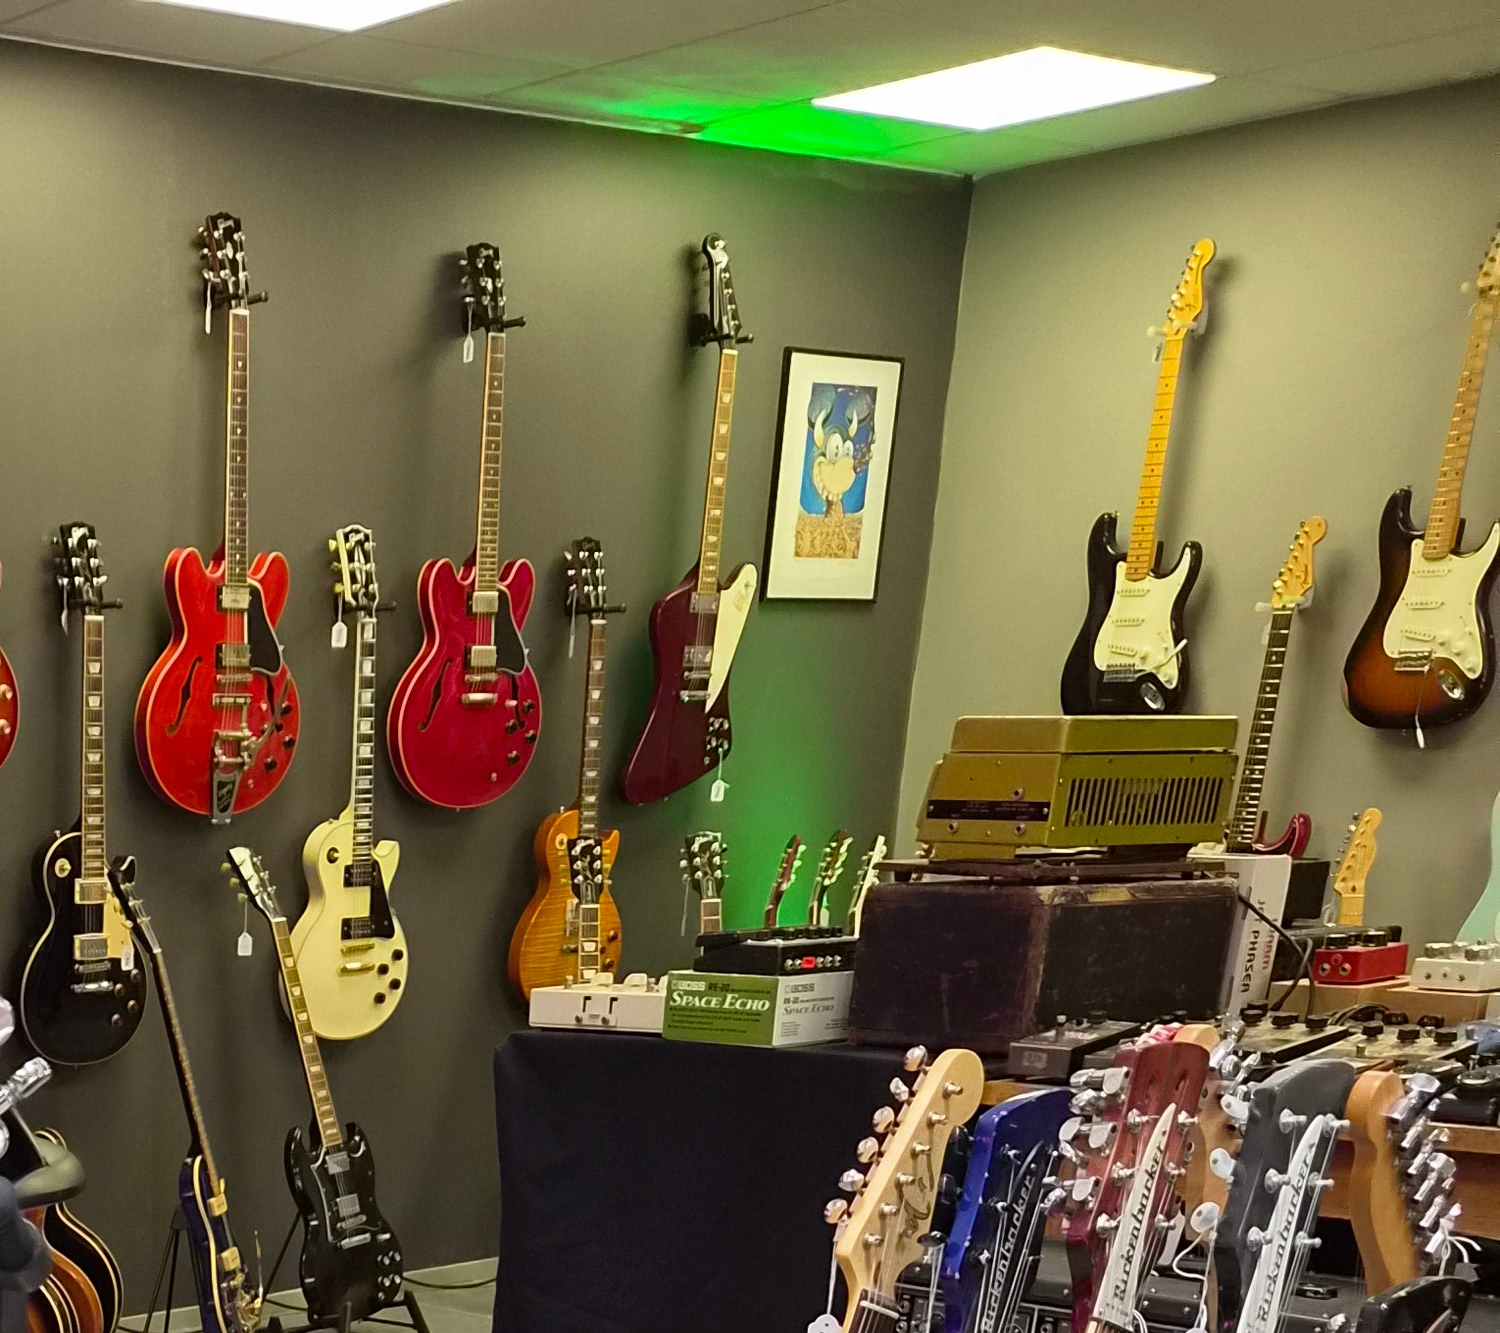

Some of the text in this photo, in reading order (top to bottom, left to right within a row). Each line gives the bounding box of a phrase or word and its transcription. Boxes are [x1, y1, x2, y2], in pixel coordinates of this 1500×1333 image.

[1241, 930, 1260, 993] PHASER
[670, 991, 770, 1011] SPACE ECHO
[678, 981, 706, 991] BOSS
[790, 983, 815, 993] BOSS
[1114, 1143, 1165, 1302] Rickenbacker
[1256, 1153, 1311, 1322] Rickenbacker
